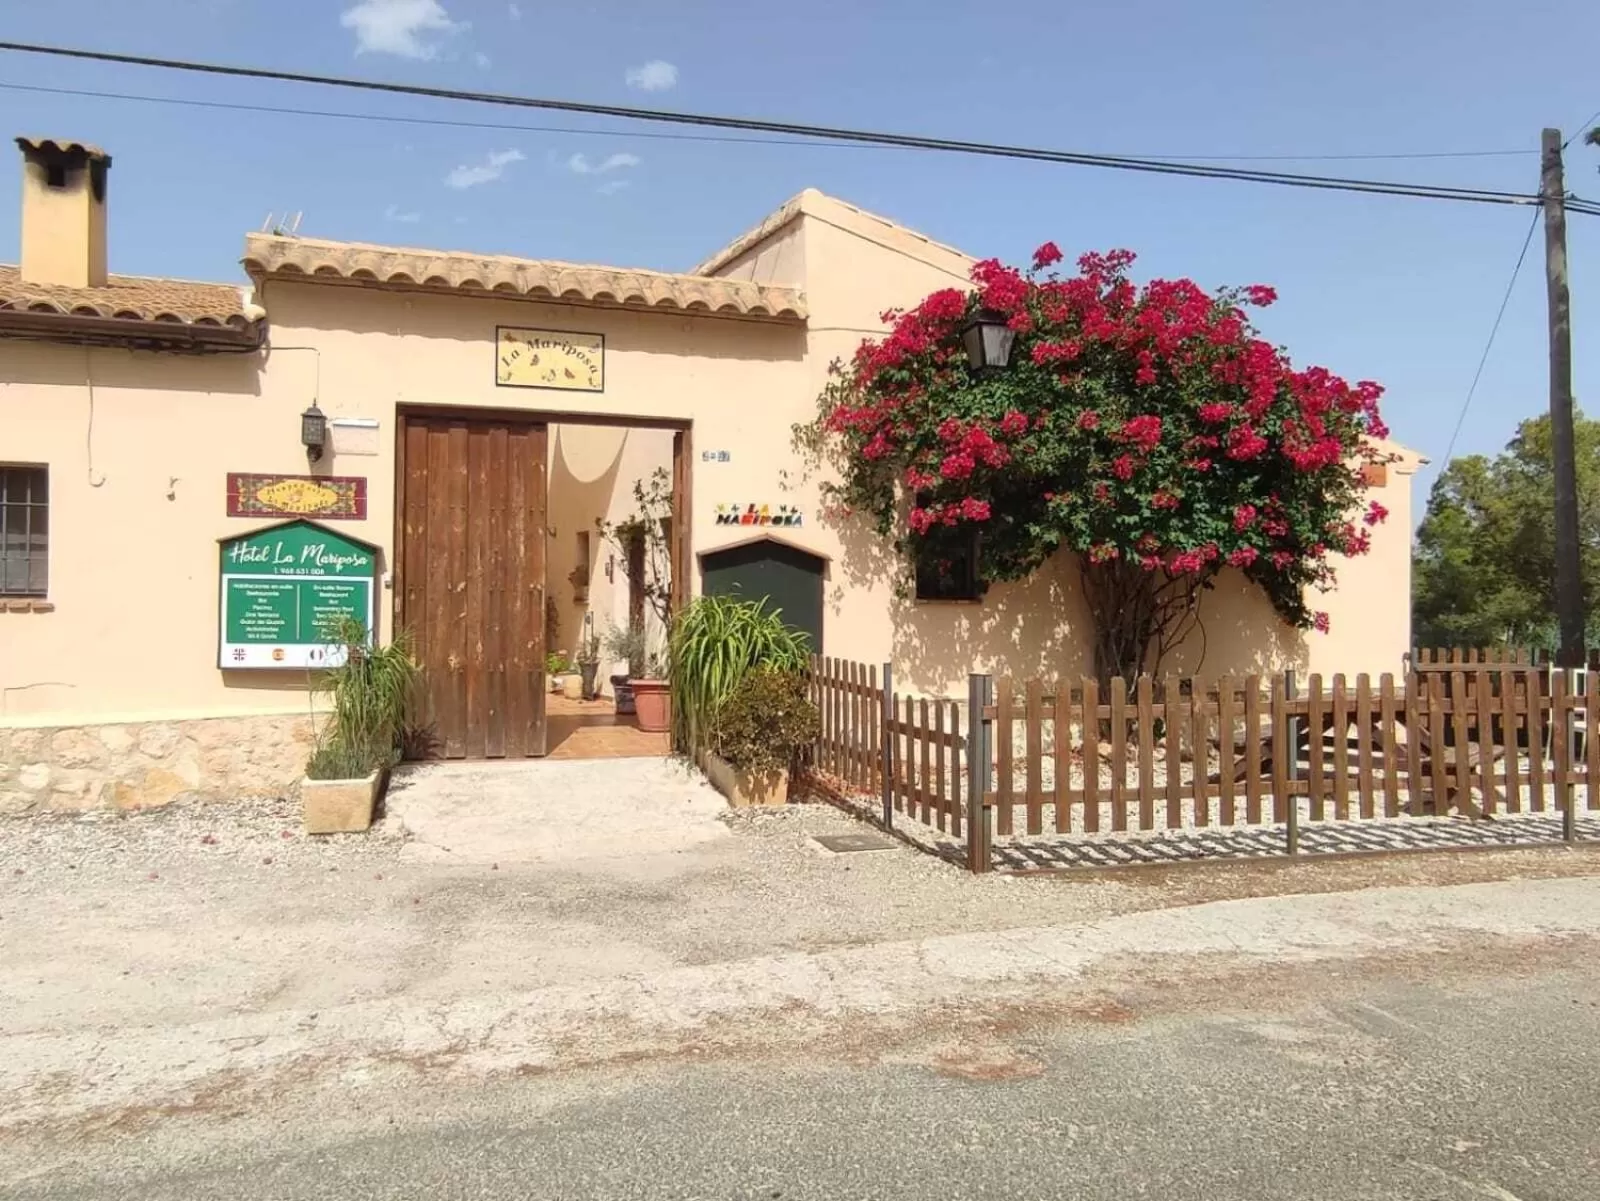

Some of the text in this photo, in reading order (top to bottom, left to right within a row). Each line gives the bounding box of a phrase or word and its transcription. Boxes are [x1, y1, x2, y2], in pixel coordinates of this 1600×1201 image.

[501, 338, 598, 373] La Mariposa
[229, 541, 368, 573] Hotel La Mariposa
